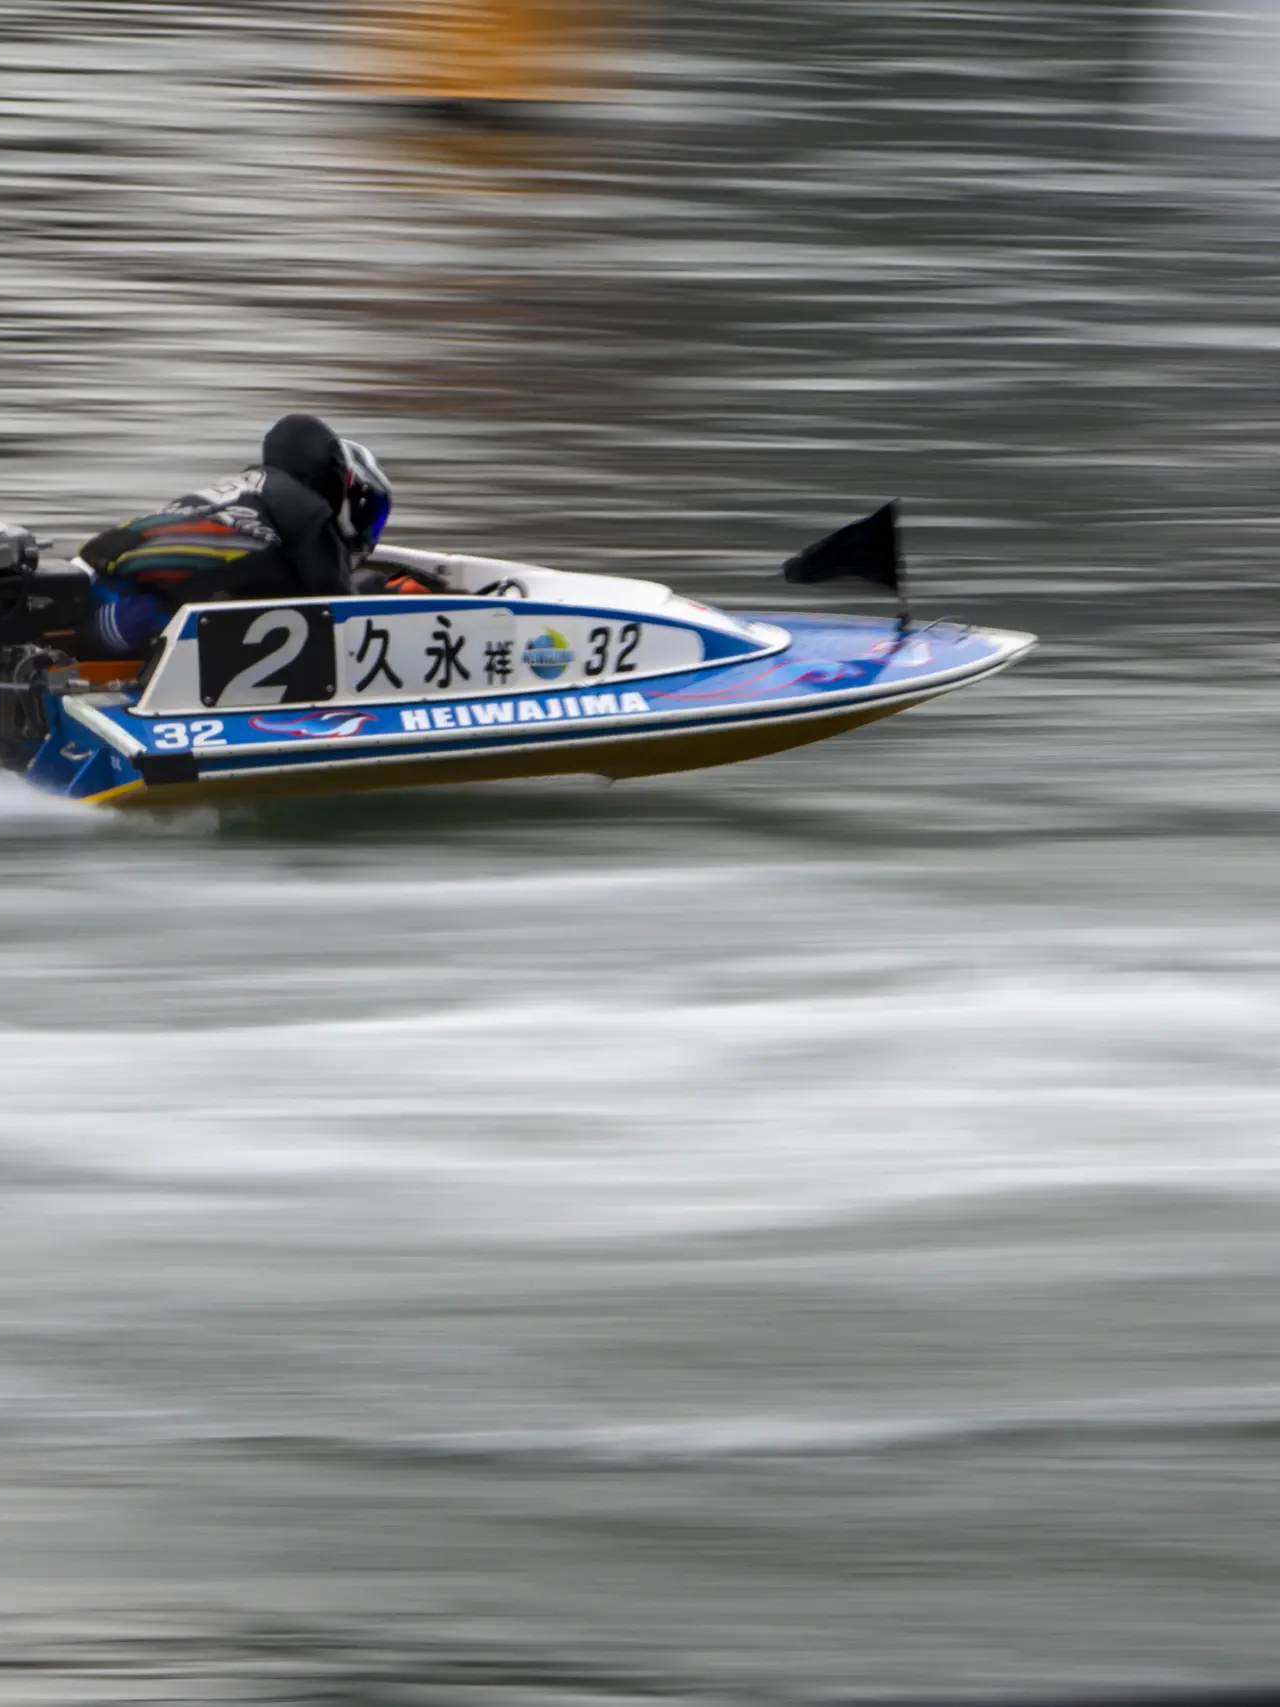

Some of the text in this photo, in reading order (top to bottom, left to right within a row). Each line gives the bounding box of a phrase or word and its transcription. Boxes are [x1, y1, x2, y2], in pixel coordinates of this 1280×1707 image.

[216, 609, 309, 707] 2
[584, 622, 641, 676] 32
[152, 719, 228, 749] 32
[400, 691, 651, 731] HEIWAJIMA
